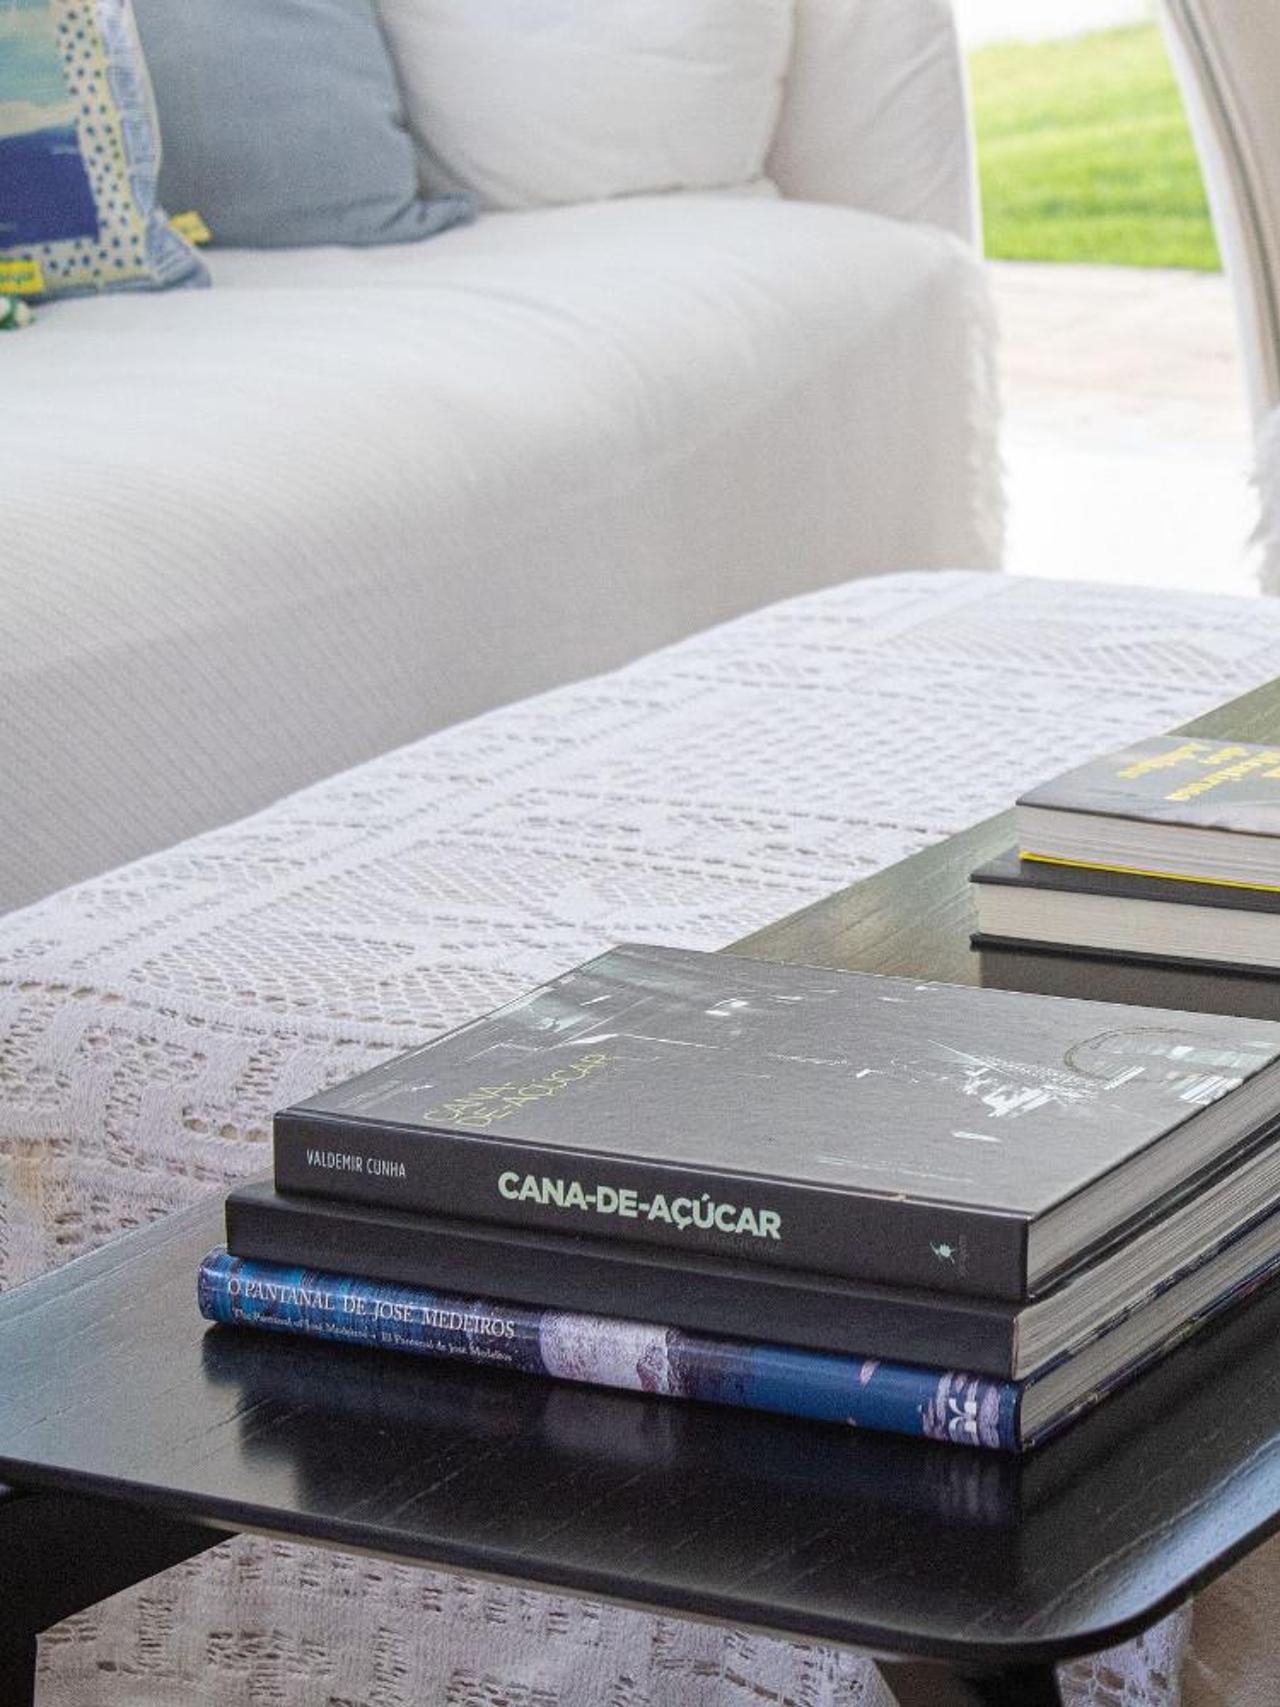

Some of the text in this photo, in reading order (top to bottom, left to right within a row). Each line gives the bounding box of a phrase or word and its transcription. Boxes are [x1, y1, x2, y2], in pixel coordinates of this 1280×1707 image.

[306, 1148, 406, 1178] VALDEMIR CUNHA
[498, 1171, 781, 1239] CANA-DE-AÇÚCAR
[228, 1278, 241, 1295] O
[245, 1280, 335, 1311] PANTANAL
[343, 1295, 367, 1316] DE
[422, 1307, 515, 1339] MEDEIROS
